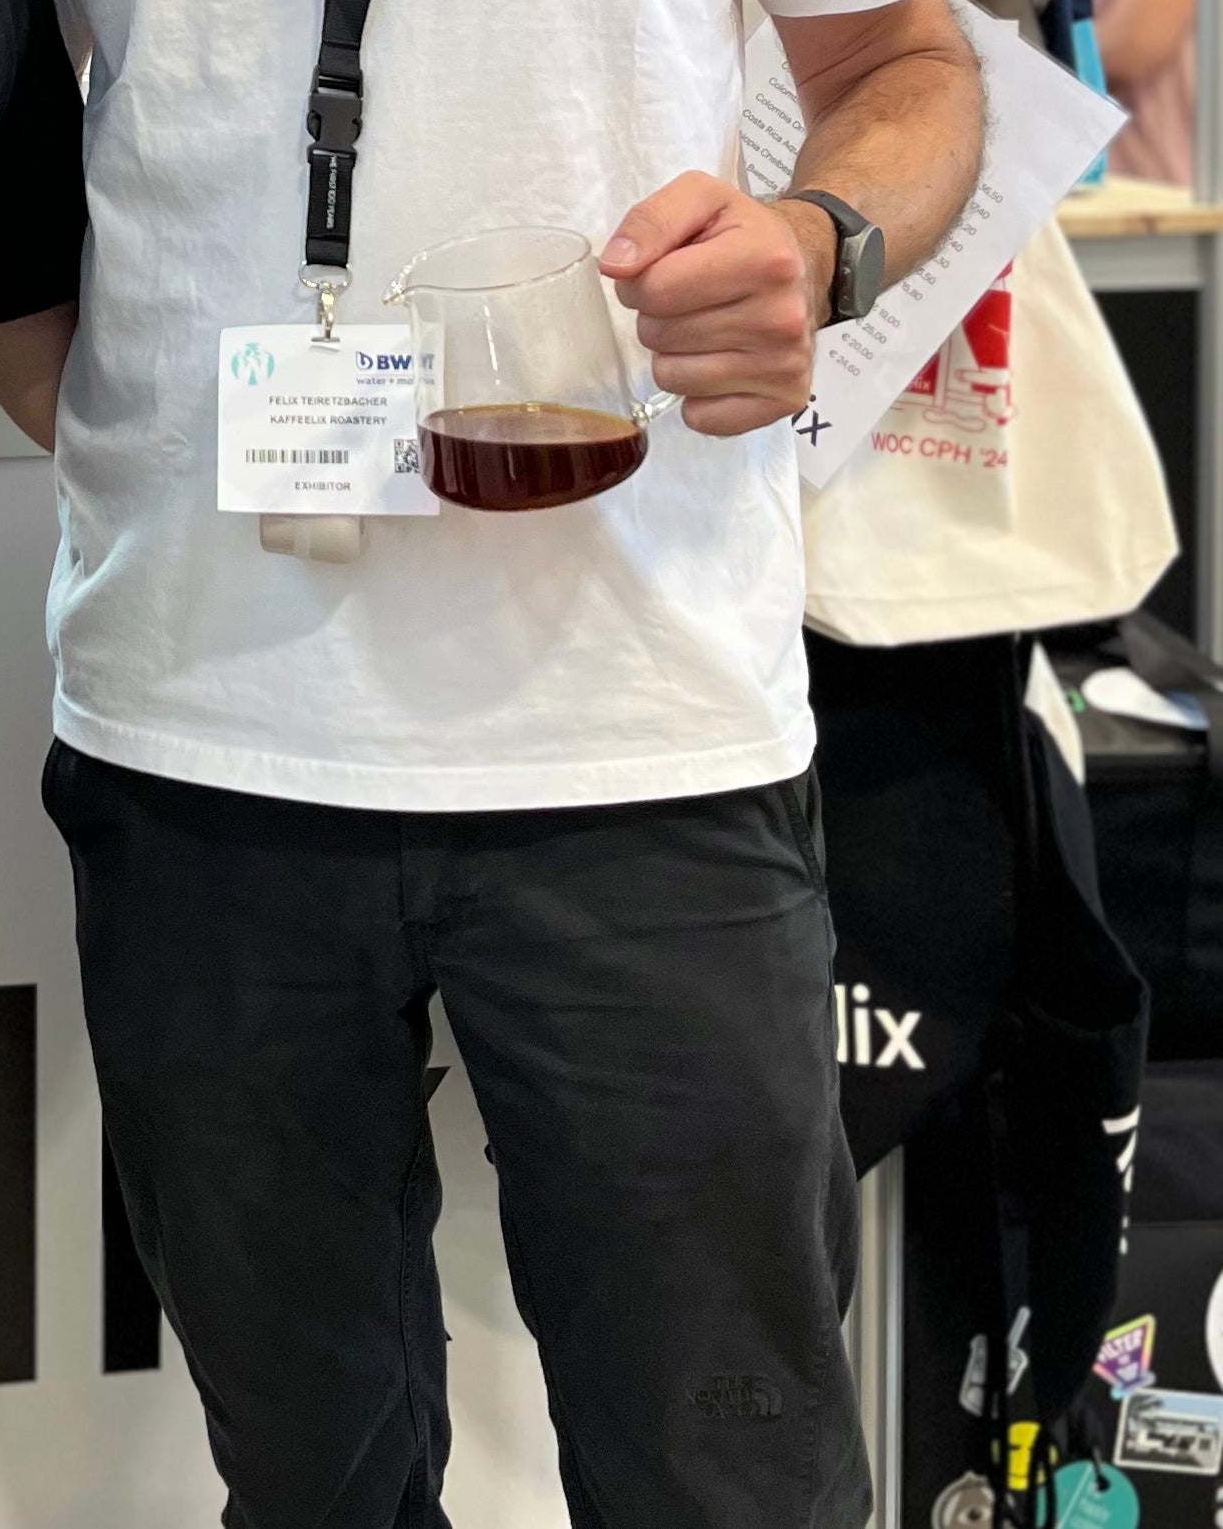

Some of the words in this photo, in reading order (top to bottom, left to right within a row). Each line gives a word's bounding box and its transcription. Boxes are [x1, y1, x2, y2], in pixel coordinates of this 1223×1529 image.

[742, 109, 765, 130] Costa
[765, 125, 782, 143] Rica
[356, 377, 386, 385] water
[269, 396, 298, 405] FELIX
[270, 415, 327, 425] KAFFEELIX
[330, 416, 387, 425] ROASTERY
[872, 432, 913, 455] WOC
[920, 438, 971, 464] CPH
[295, 482, 351, 491] EXHIBITOR
